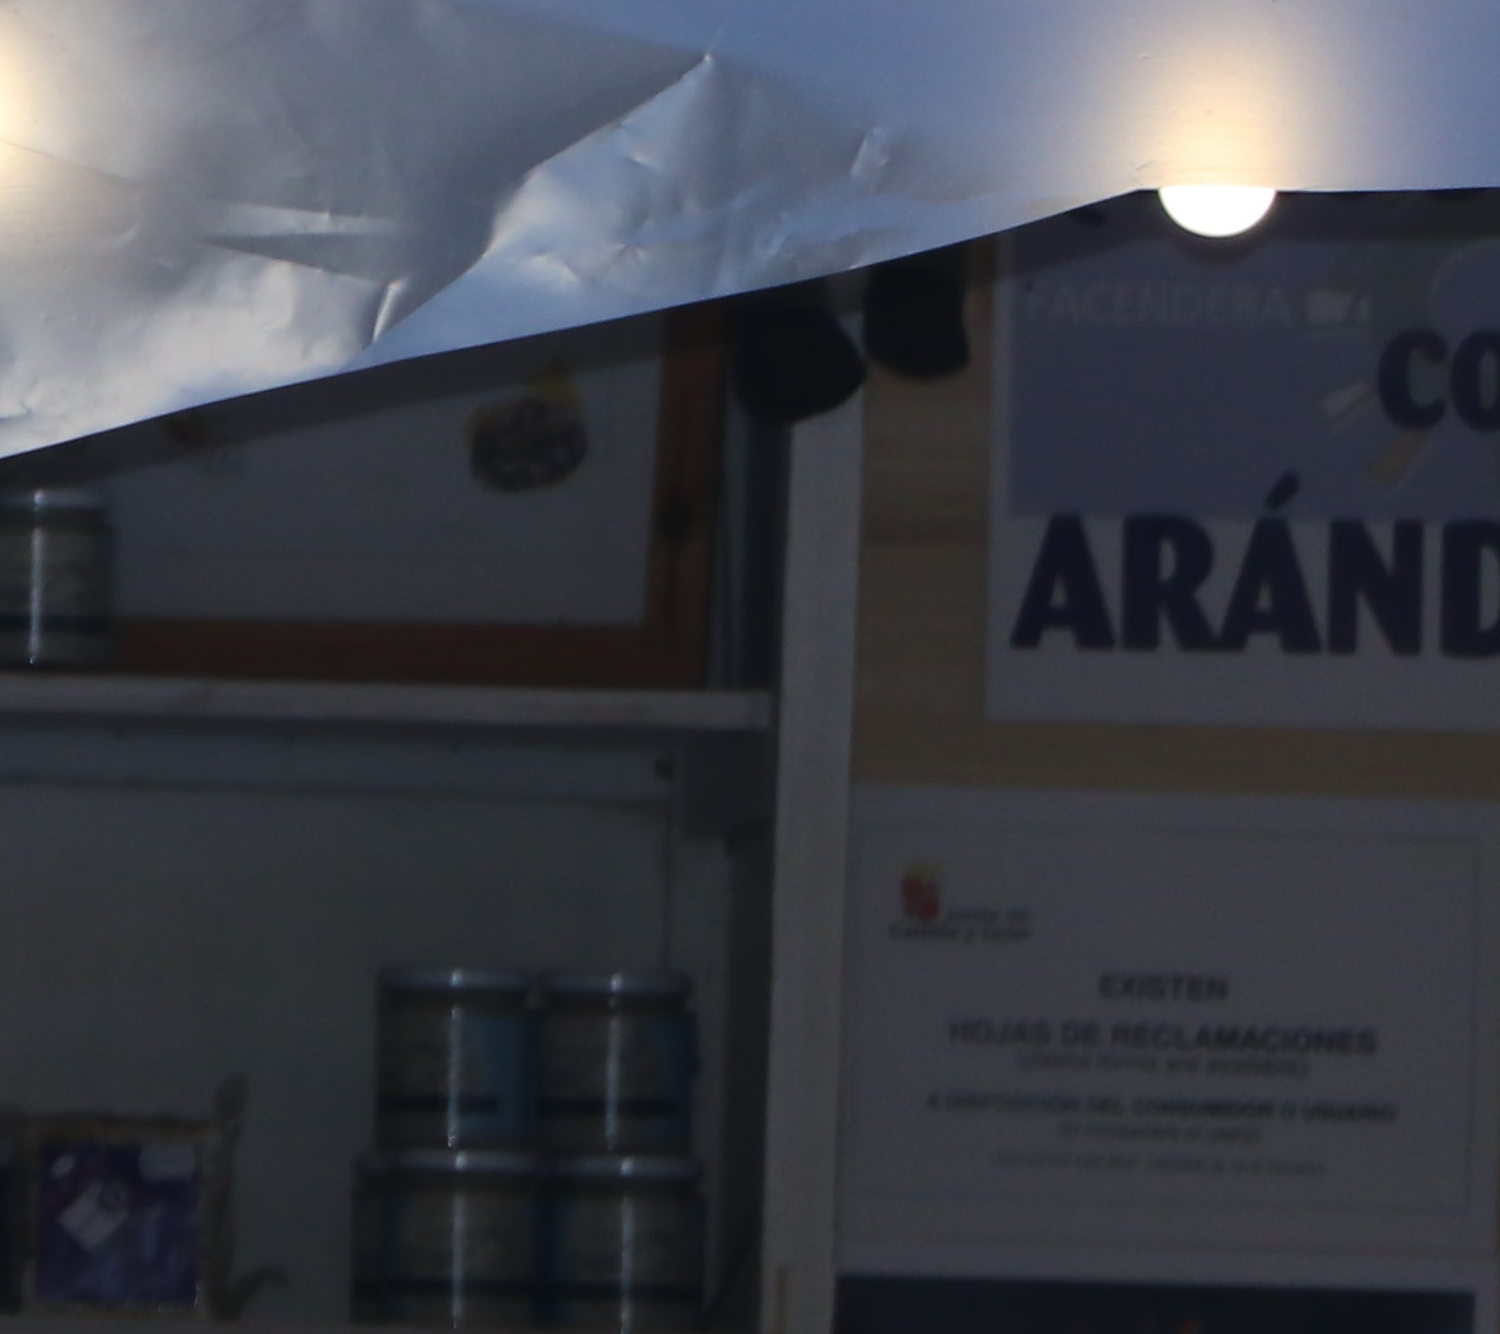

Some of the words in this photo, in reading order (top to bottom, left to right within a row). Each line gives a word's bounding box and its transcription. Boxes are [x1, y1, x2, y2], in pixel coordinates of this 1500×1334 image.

[1097, 972, 1230, 1001] EXISTEN
[949, 1018, 1052, 1047] HOJAS
[1060, 1020, 1101, 1047] DE
[1110, 1022, 1380, 1057] RECLAMACIONES
